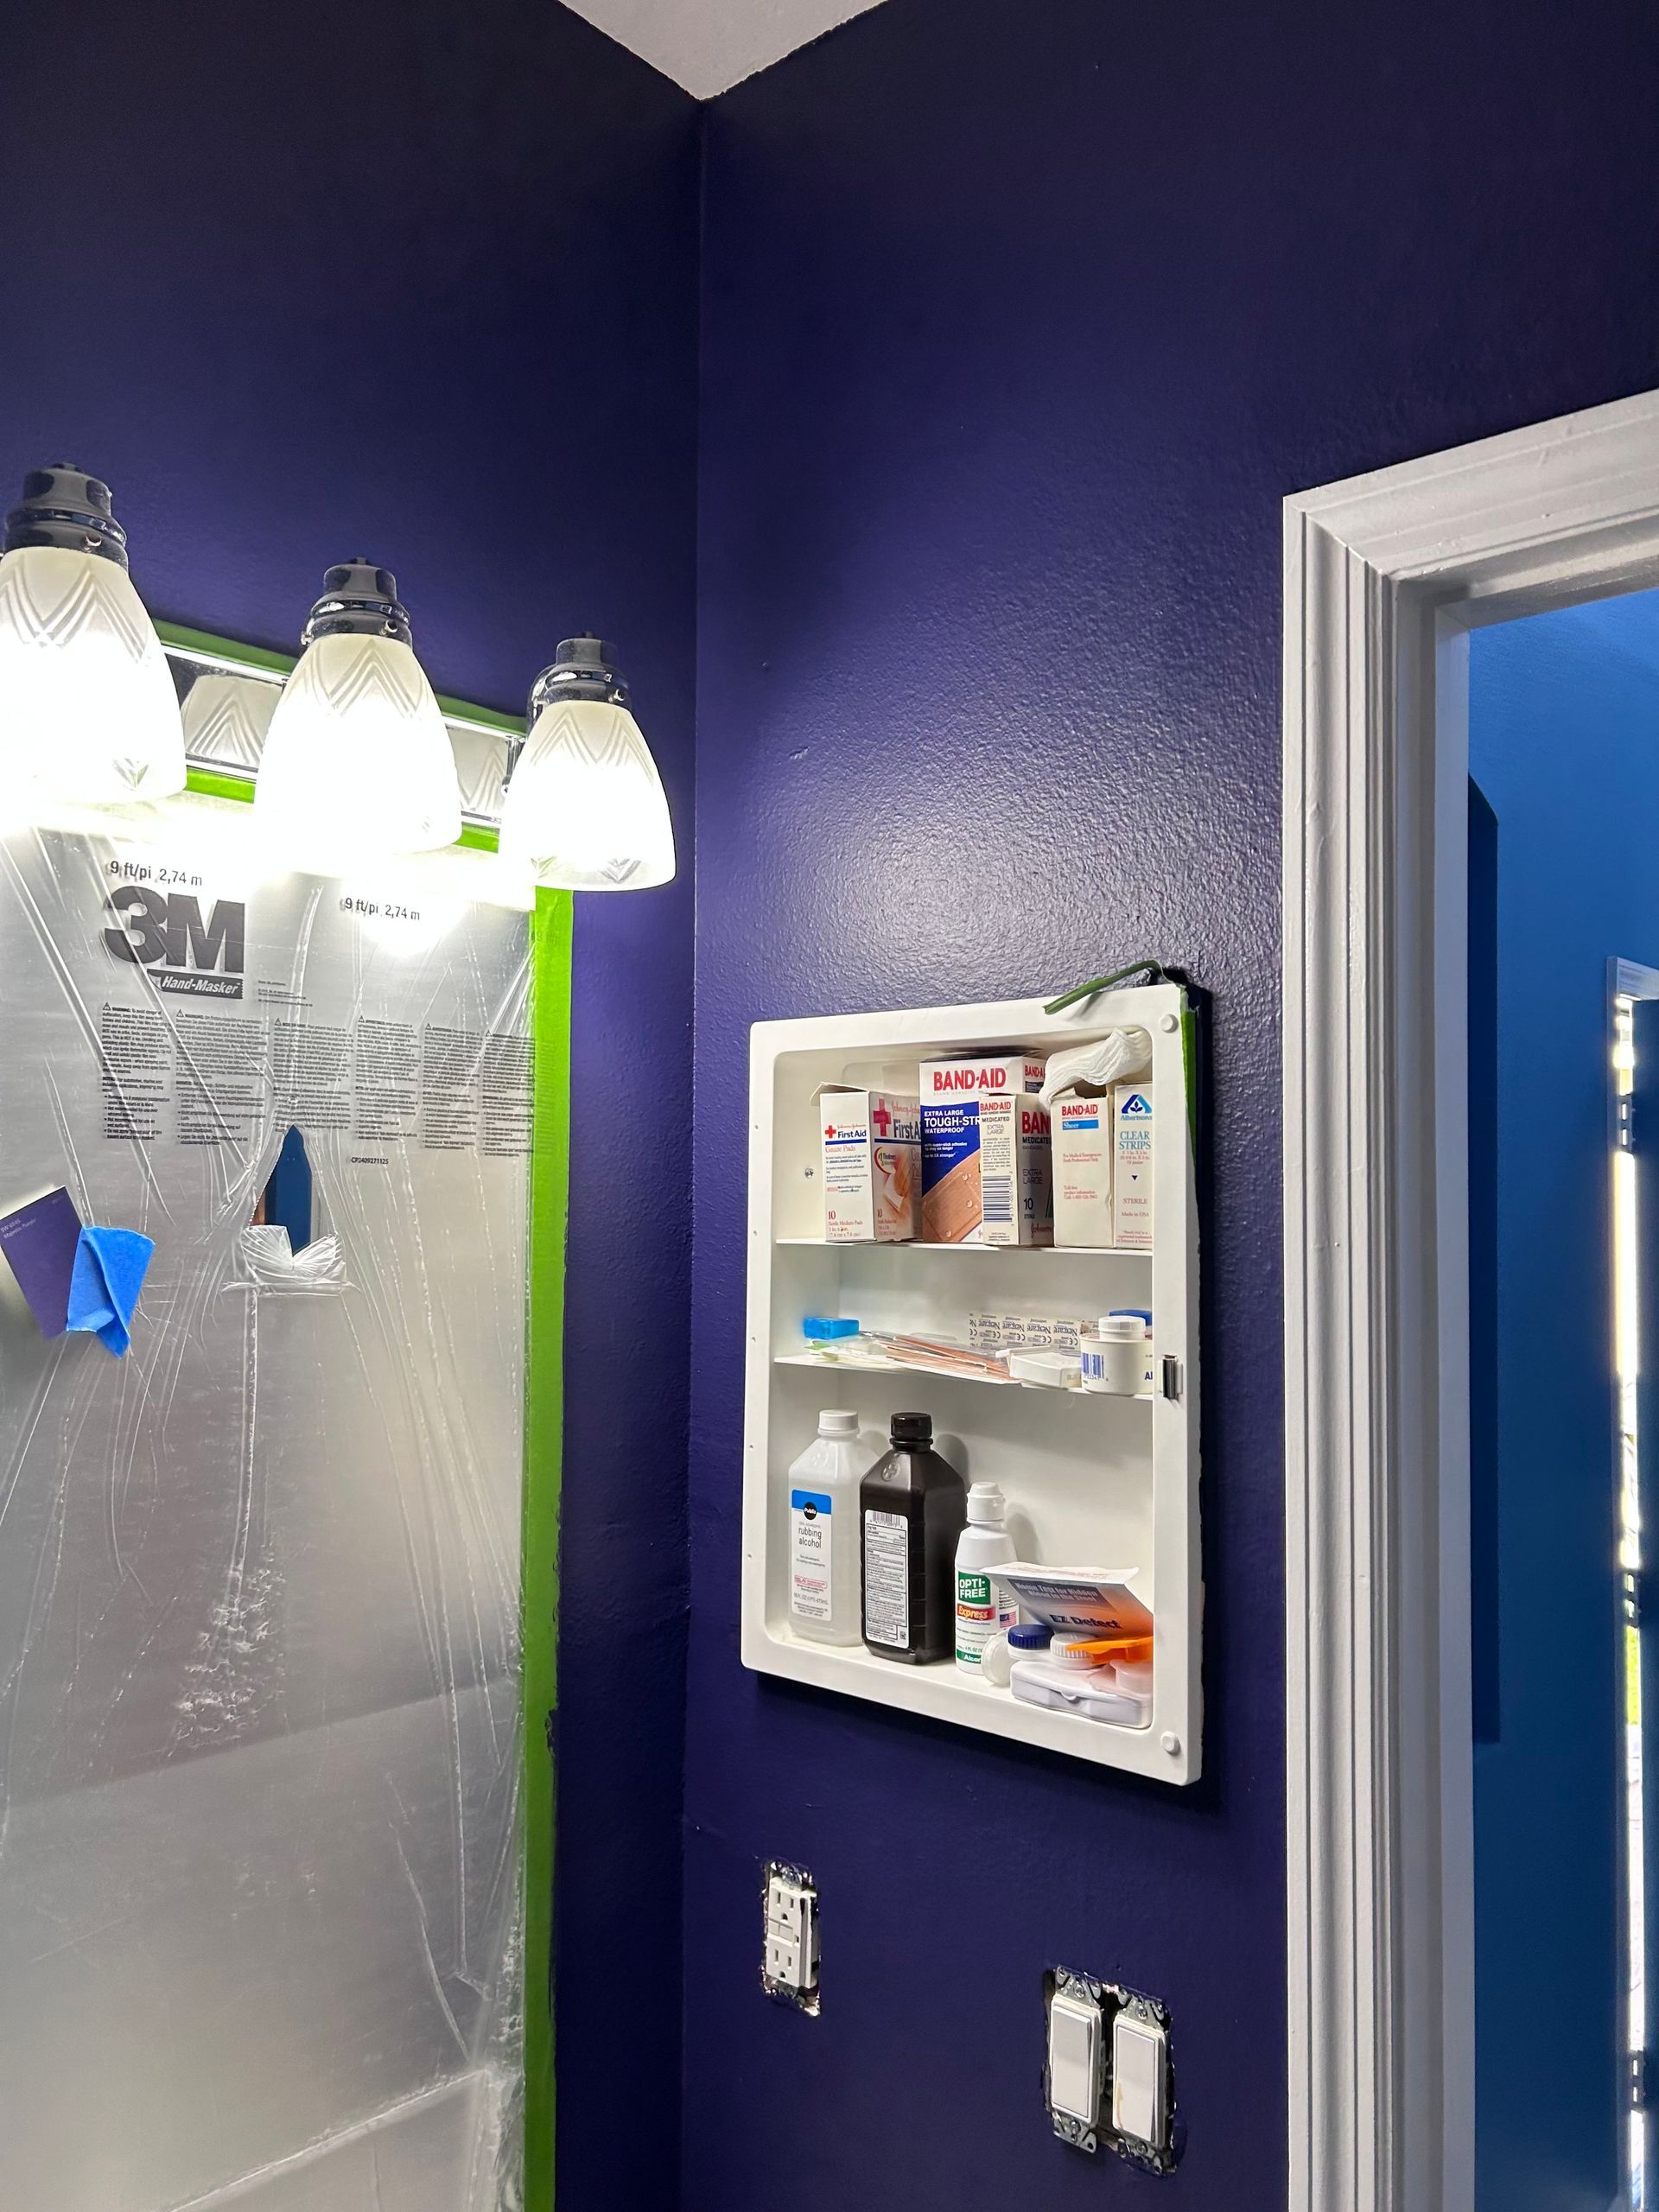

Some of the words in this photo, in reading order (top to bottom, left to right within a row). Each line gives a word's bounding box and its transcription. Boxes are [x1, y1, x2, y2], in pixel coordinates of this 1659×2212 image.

[111, 861, 118, 874] 9
[124, 862, 151, 880] ft/pi
[159, 868, 187, 885] 2,74
[191, 875, 202, 886] m
[346, 898, 353, 909] 9
[356, 899, 378, 915] ft/pi
[385, 905, 407, 918] 2,74
[410, 911, 420, 920] m
[104, 886, 245, 974] 3M
[162, 976, 239, 995] Hand-Masker
[1025, 1065, 1045, 1078] BAND-A
[933, 1067, 1007, 1091] BAND-AID
[980, 1102, 1011, 1111] BAND-AID
[1062, 1104, 1098, 1116] BAND-AID
[925, 1116, 981, 1128] TOUGH-STR
[1022, 1111, 1052, 1135] BAN
[893, 1119, 914, 1140] First
[1120, 1131, 1150, 1141] CLEAR
[1119, 1141, 1152, 1150] STRIPS
[1023, 1176, 1043, 1185] LARGE
[1024, 1197, 1033, 1211] 10
[828, 1211, 836, 1220] 10
[978, 1319, 1001, 1330] Nexcare
[1002, 1321, 1025, 1332] Nexcare
[1027, 1324, 1051, 1334] Nexcare
[1053, 1325, 1077, 1336] Nexcare
[798, 1527, 822, 1540] rubbing
[798, 1536, 822, 1548] alcohol
[959, 1578, 985, 1588] OPTI-
[960, 1588, 986, 1599] FREE
[1037, 1584, 1053, 1592] Test
[1066, 1587, 1099, 1598] Hidden
[959, 1606, 988, 1620] Express
[1049, 1614, 1070, 1624] EZ
[1070, 1616, 1123, 1630] Detect
